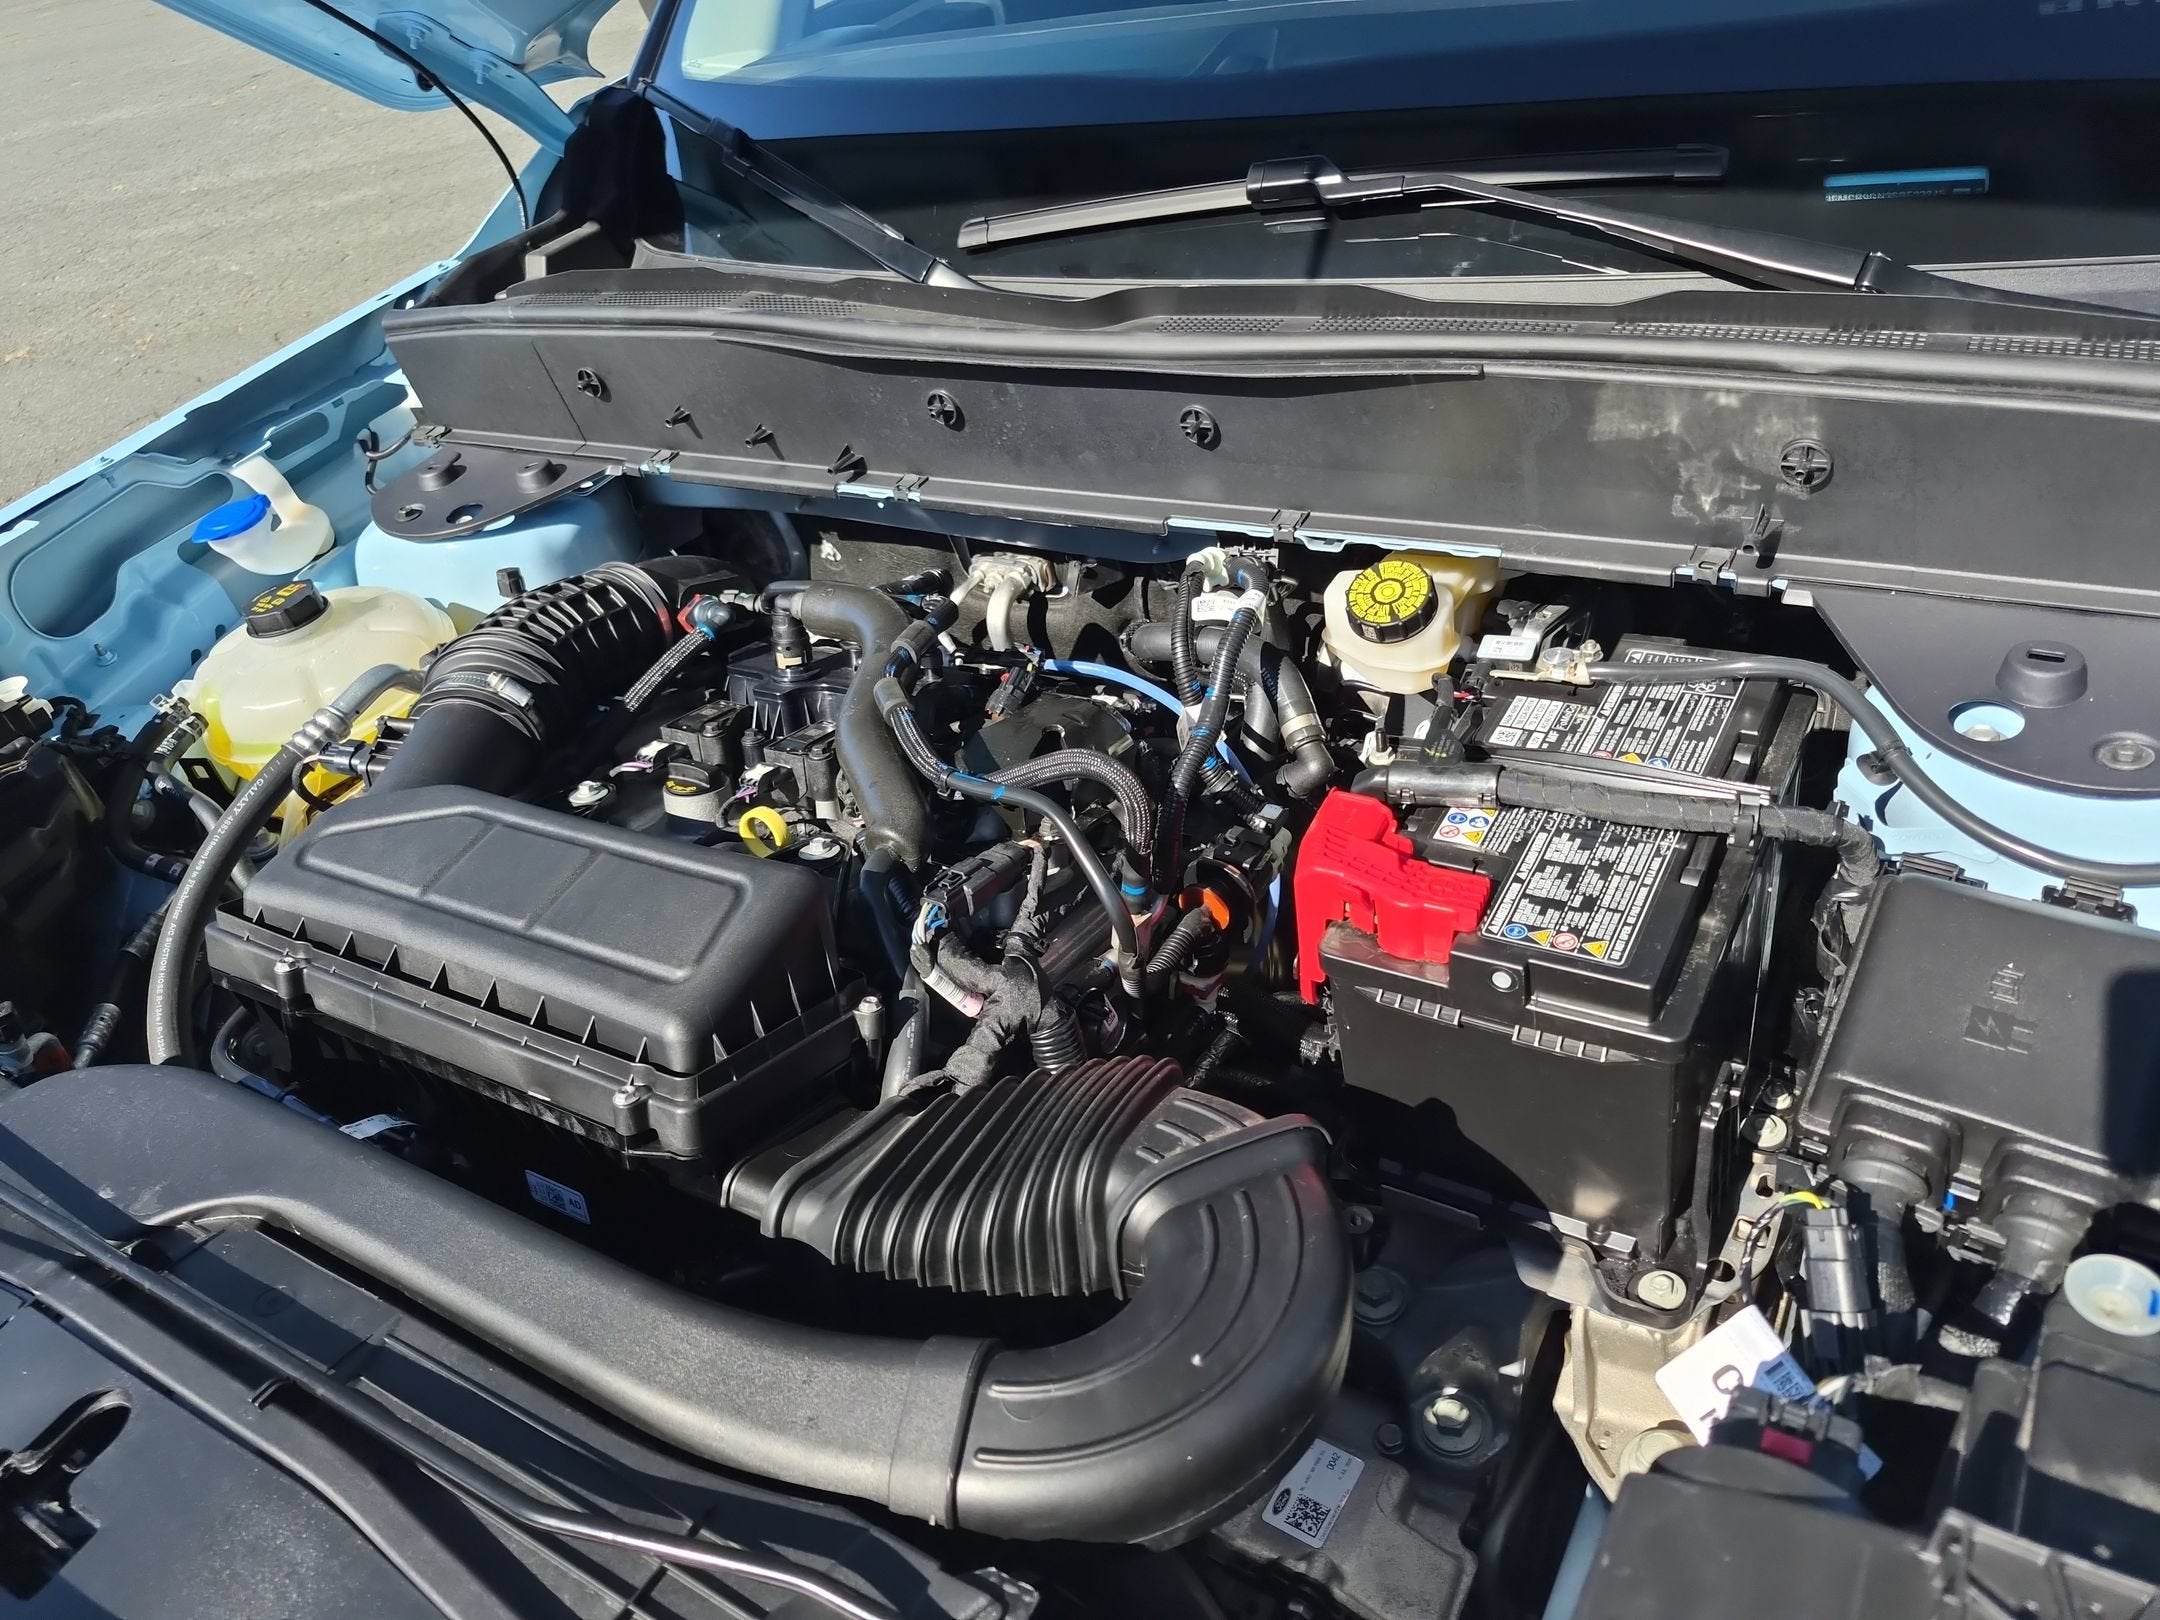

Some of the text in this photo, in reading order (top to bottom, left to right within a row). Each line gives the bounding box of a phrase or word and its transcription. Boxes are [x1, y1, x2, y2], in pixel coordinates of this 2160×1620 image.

[1556, 705, 1577, 729] FoMoCo
[233, 778, 265, 816] GALAXY
[172, 879, 196, 919] Flexbarrier
[167, 922, 177, 936] A/C
[159, 937, 173, 972] SUCTION
[156, 972, 166, 994] HOSE
[568, 1198, 582, 1210] AD
[1327, 1452, 1341, 1471] 0042
